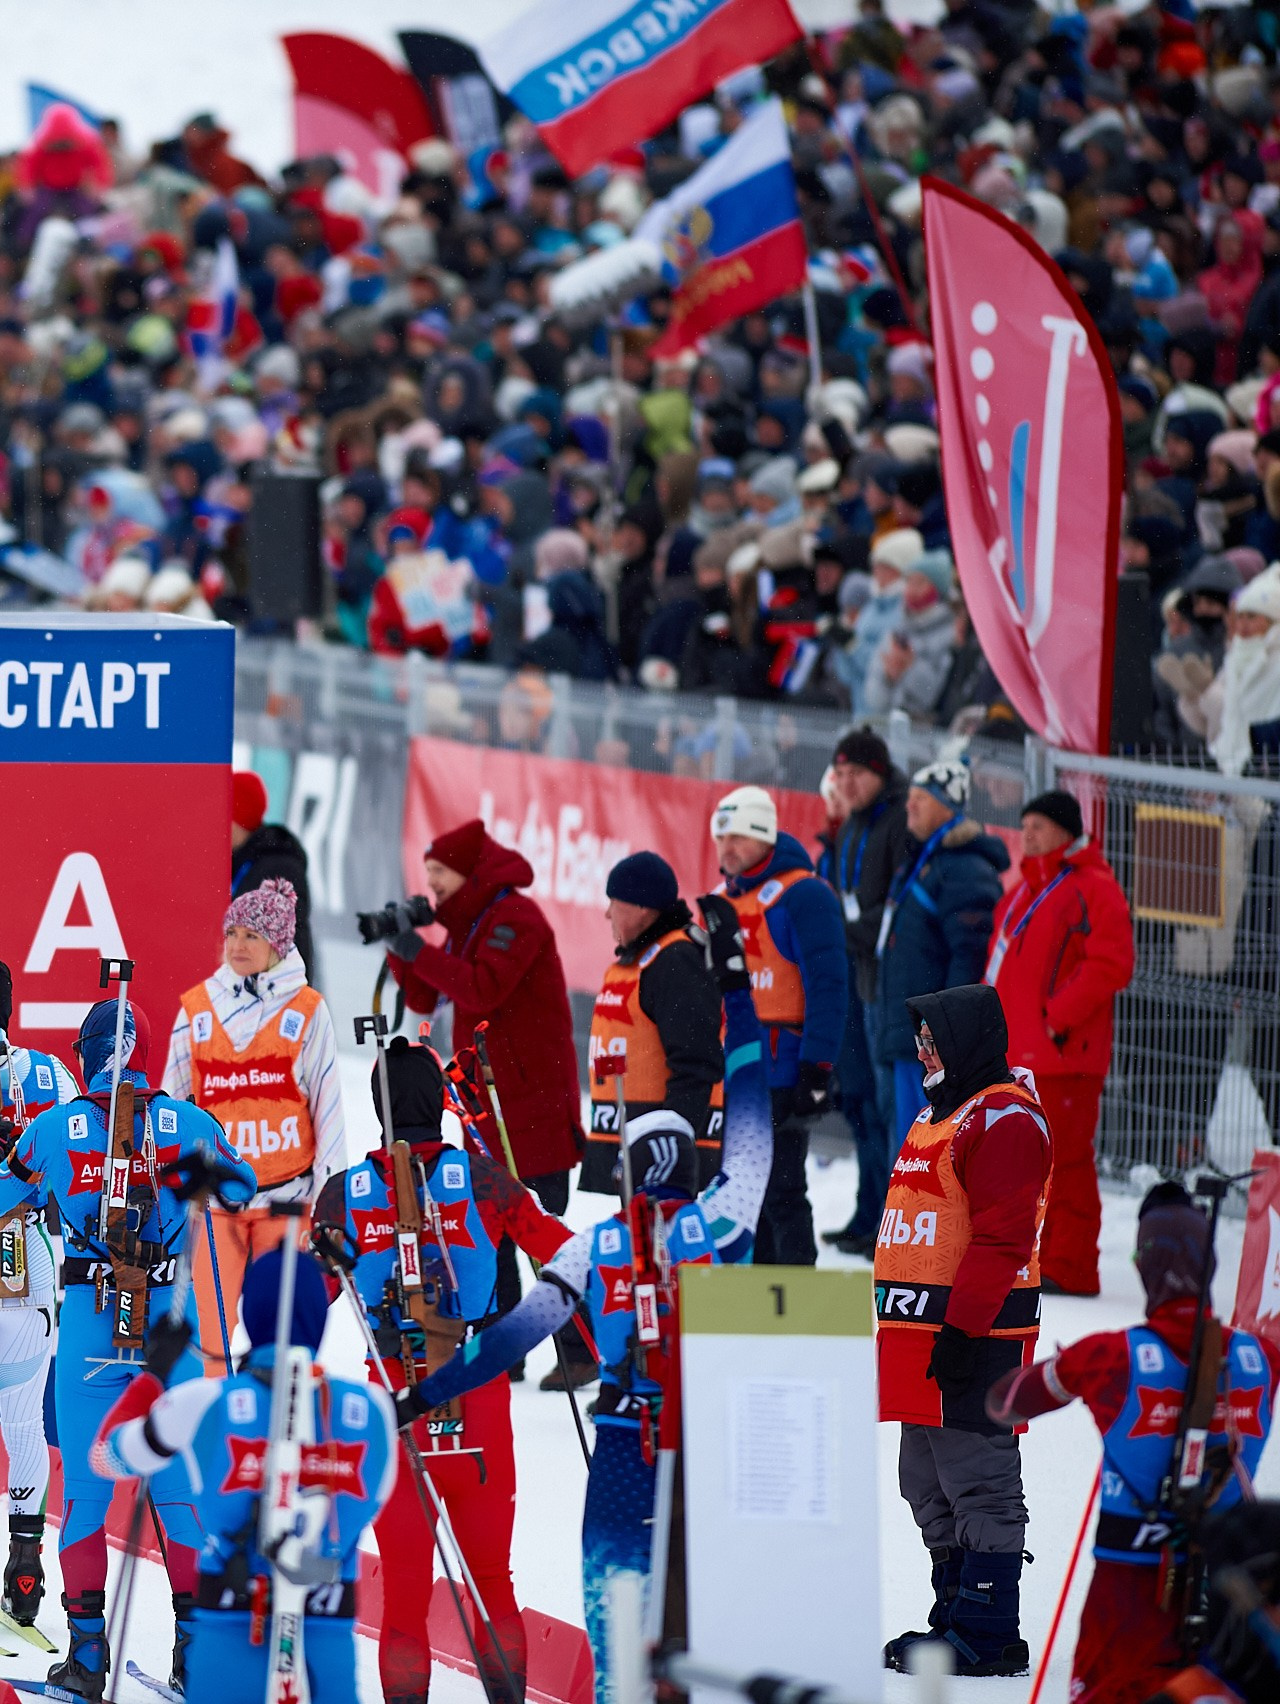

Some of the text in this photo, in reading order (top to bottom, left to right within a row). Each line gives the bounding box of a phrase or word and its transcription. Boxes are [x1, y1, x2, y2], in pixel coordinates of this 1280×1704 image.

[204, 1069, 285, 1089] Альфа Банк
[365, 1222, 395, 1237] Аль
[2, 1233, 14, 1275] PARI
[769, 1285, 786, 1316] 1
[118, 1291, 132, 1336] PARI
[44, 1683, 75, 1703] SALOMON
